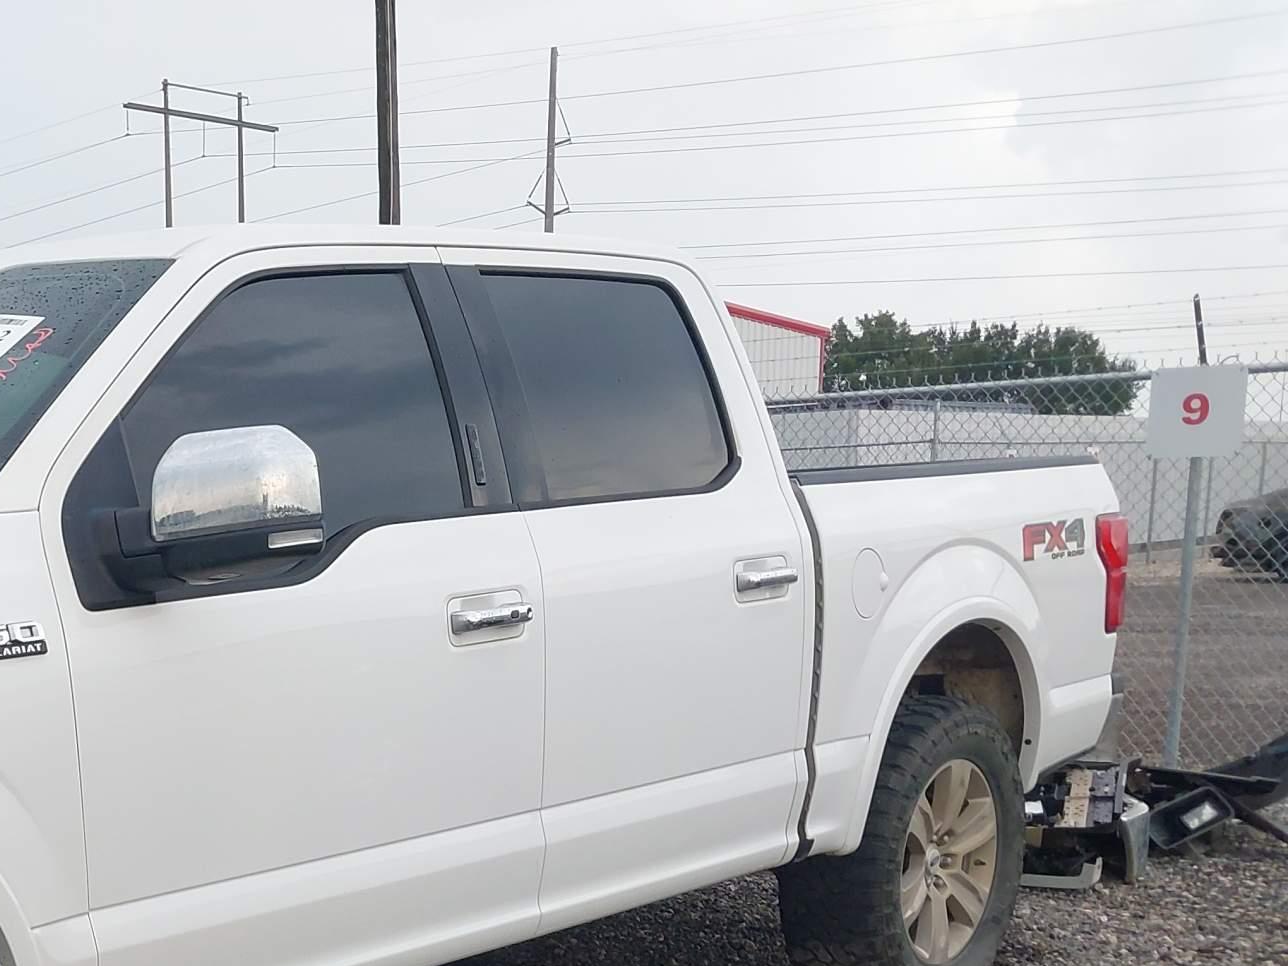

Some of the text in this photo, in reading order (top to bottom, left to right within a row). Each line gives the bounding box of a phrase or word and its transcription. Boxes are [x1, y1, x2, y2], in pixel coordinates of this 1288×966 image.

[1181, 393, 1210, 425] 9
[1022, 518, 1086, 562] FX4
[1051, 551, 1066, 560] OFF
